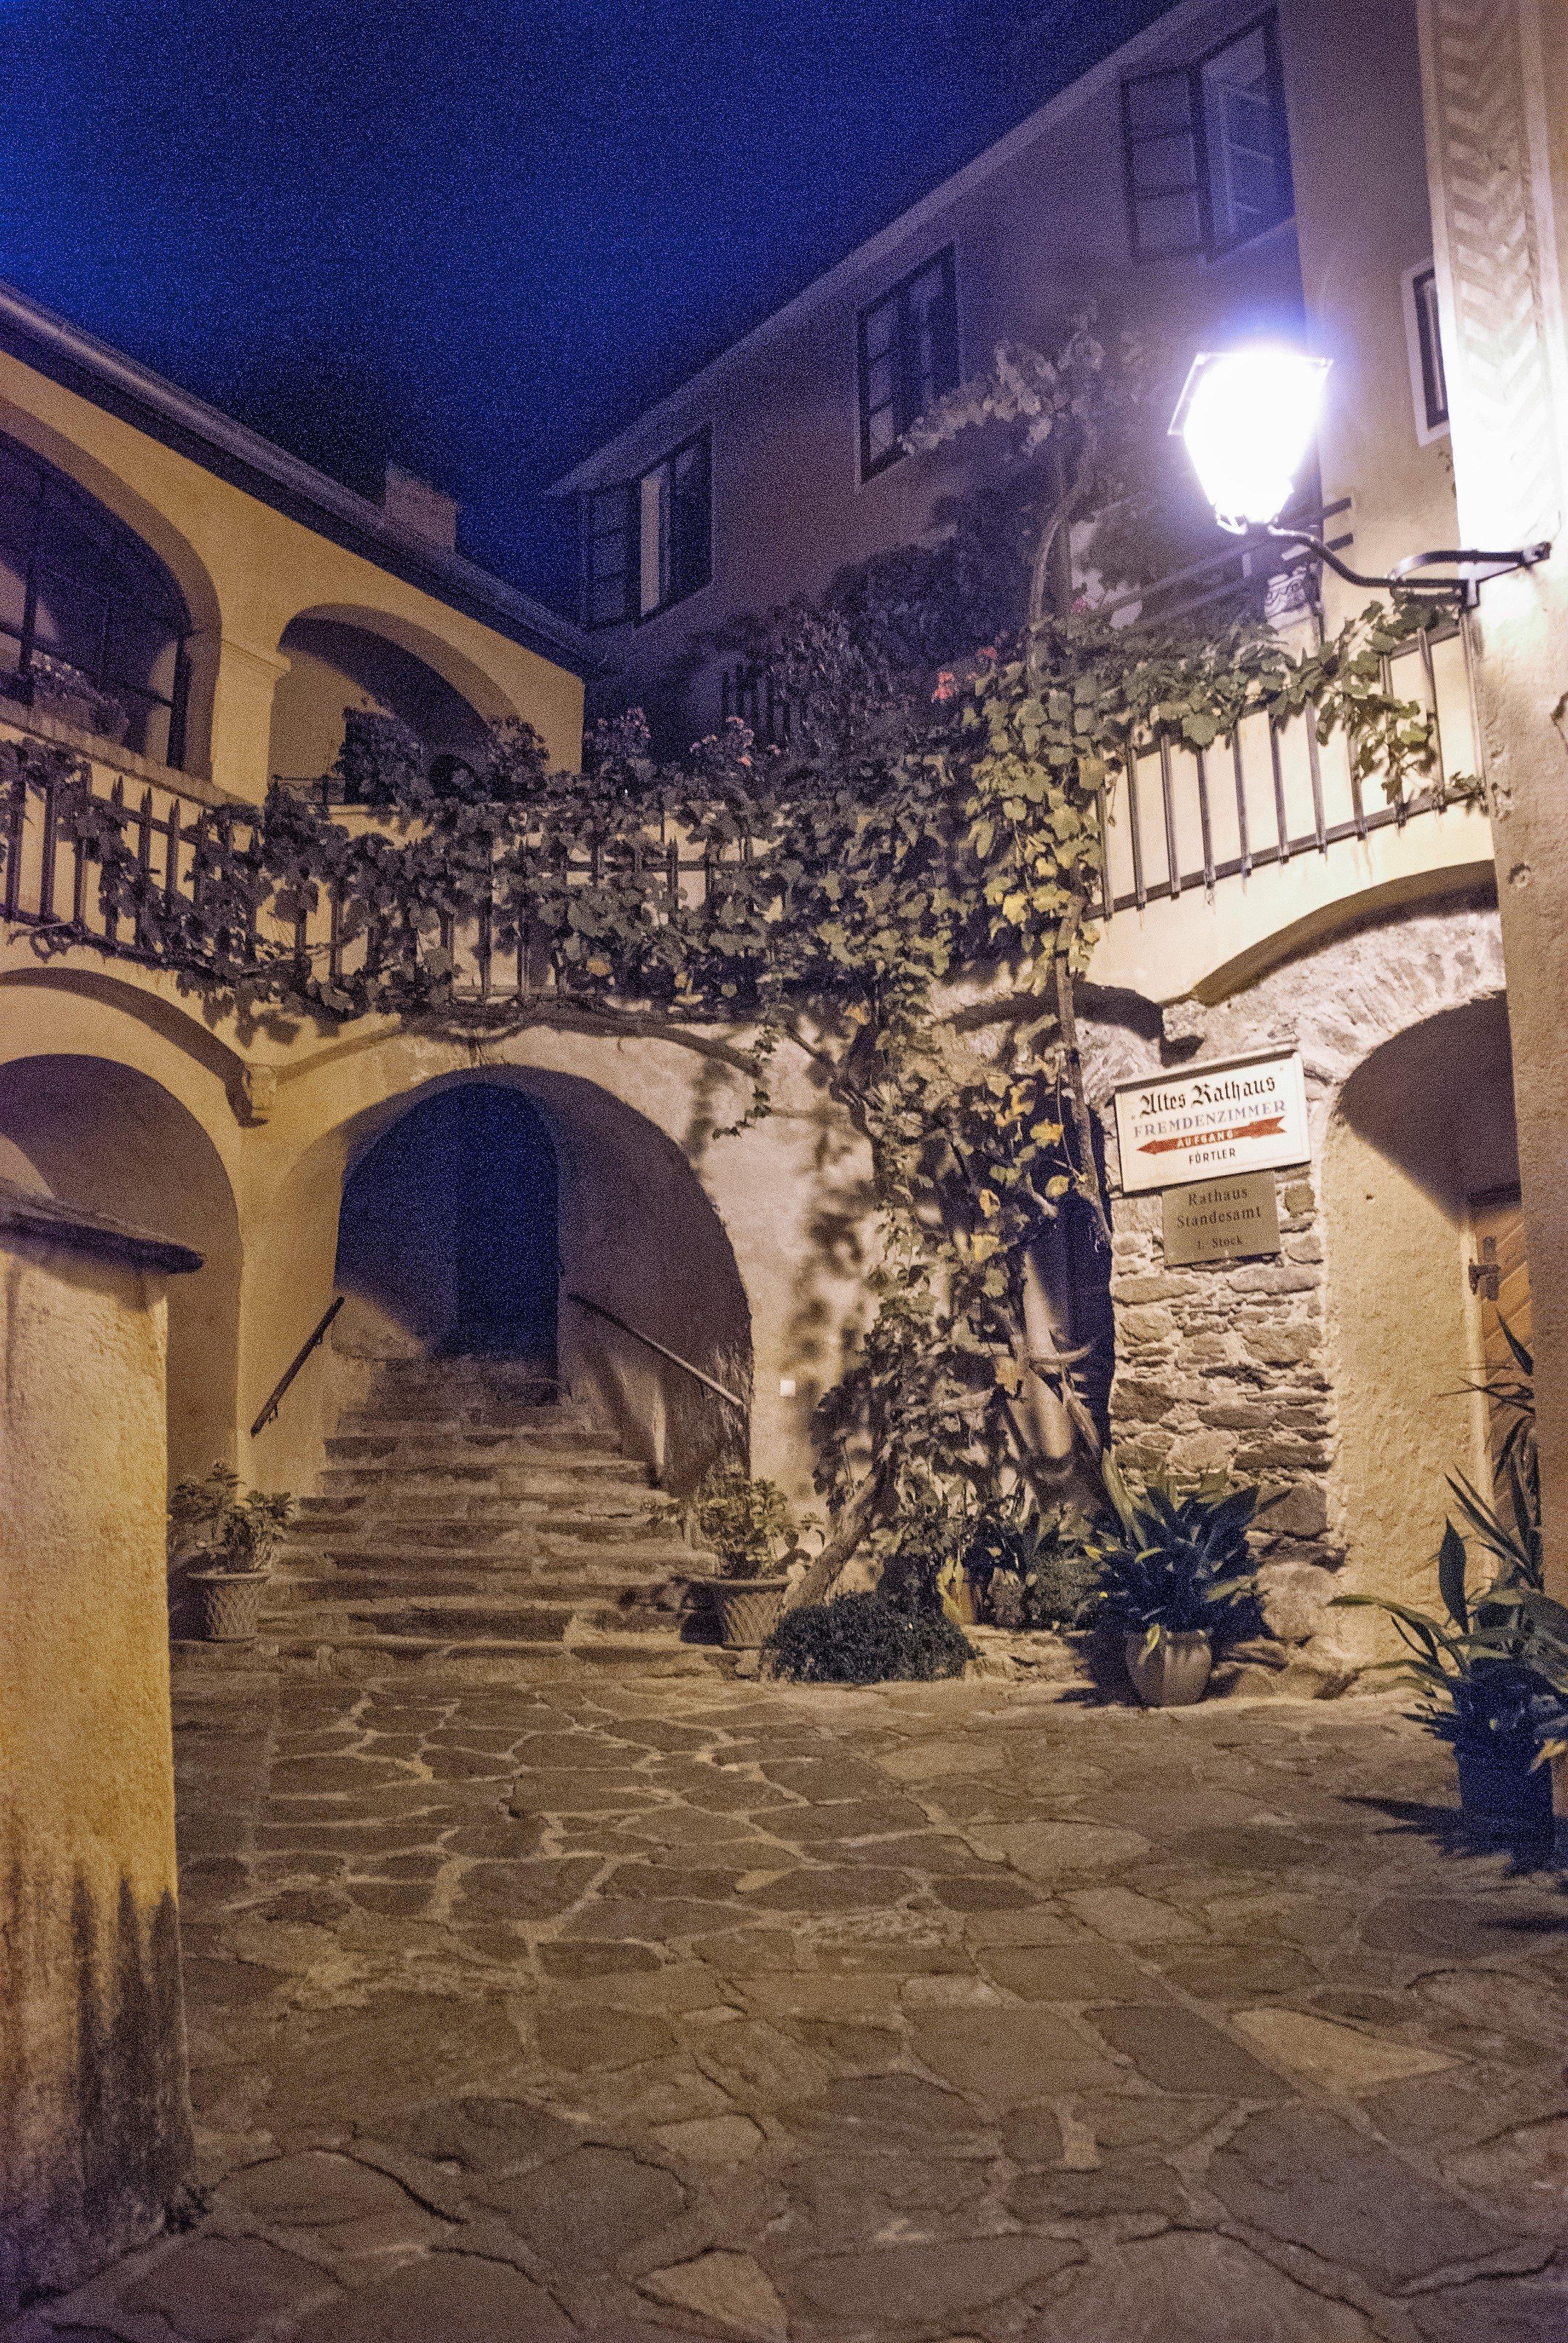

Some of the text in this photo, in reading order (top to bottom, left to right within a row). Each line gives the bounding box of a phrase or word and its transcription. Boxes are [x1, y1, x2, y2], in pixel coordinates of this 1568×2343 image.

[1134, 1099, 1287, 1138] FREMDENZIMMER
[1187, 1188, 1248, 1206] Rathaus
[1177, 1206, 1261, 1228] Standesamt
